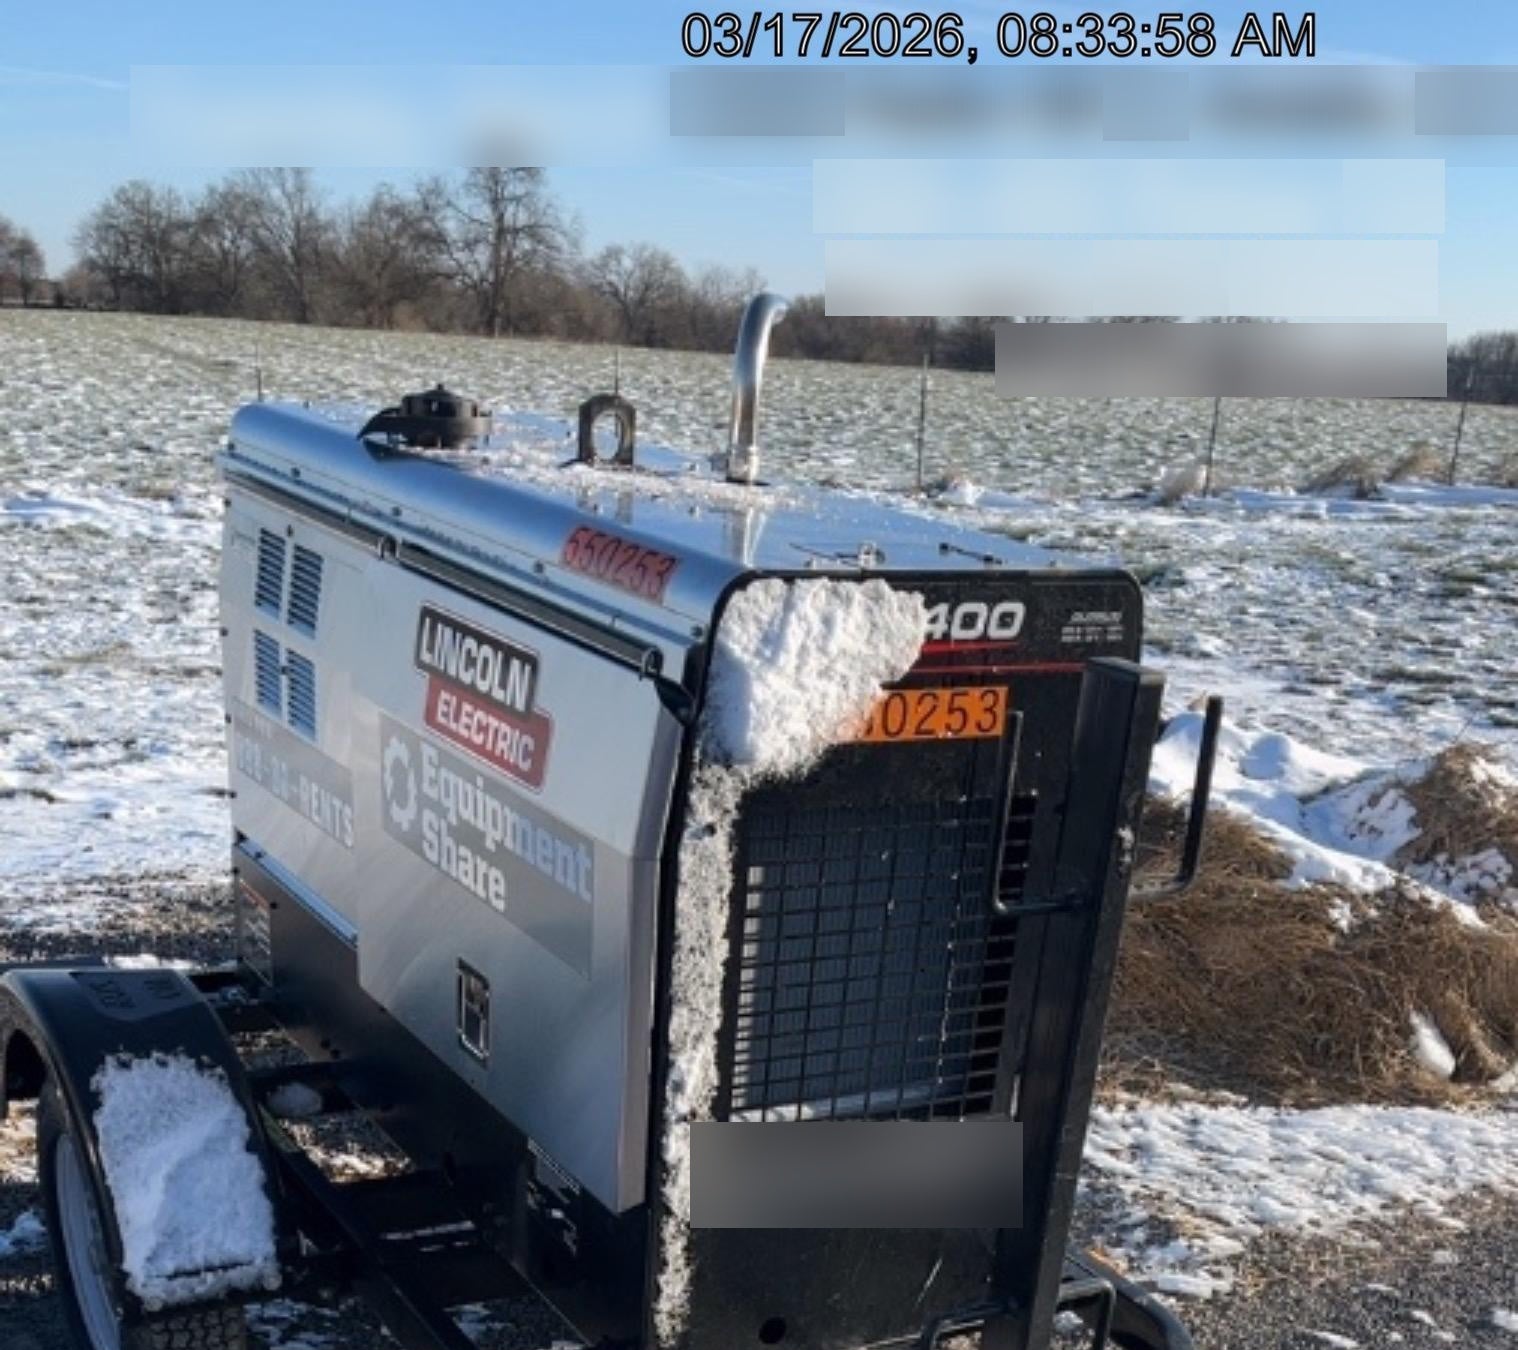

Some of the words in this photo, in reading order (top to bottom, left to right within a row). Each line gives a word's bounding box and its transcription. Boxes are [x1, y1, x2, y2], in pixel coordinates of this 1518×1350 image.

[565, 526, 677, 599] 650253
[419, 616, 532, 713] LINCOLN
[436, 689, 536, 772] ELECTRIC
[865, 688, 1001, 738] 0253
[420, 742, 592, 904] Equipment
[422, 807, 506, 913] Share
